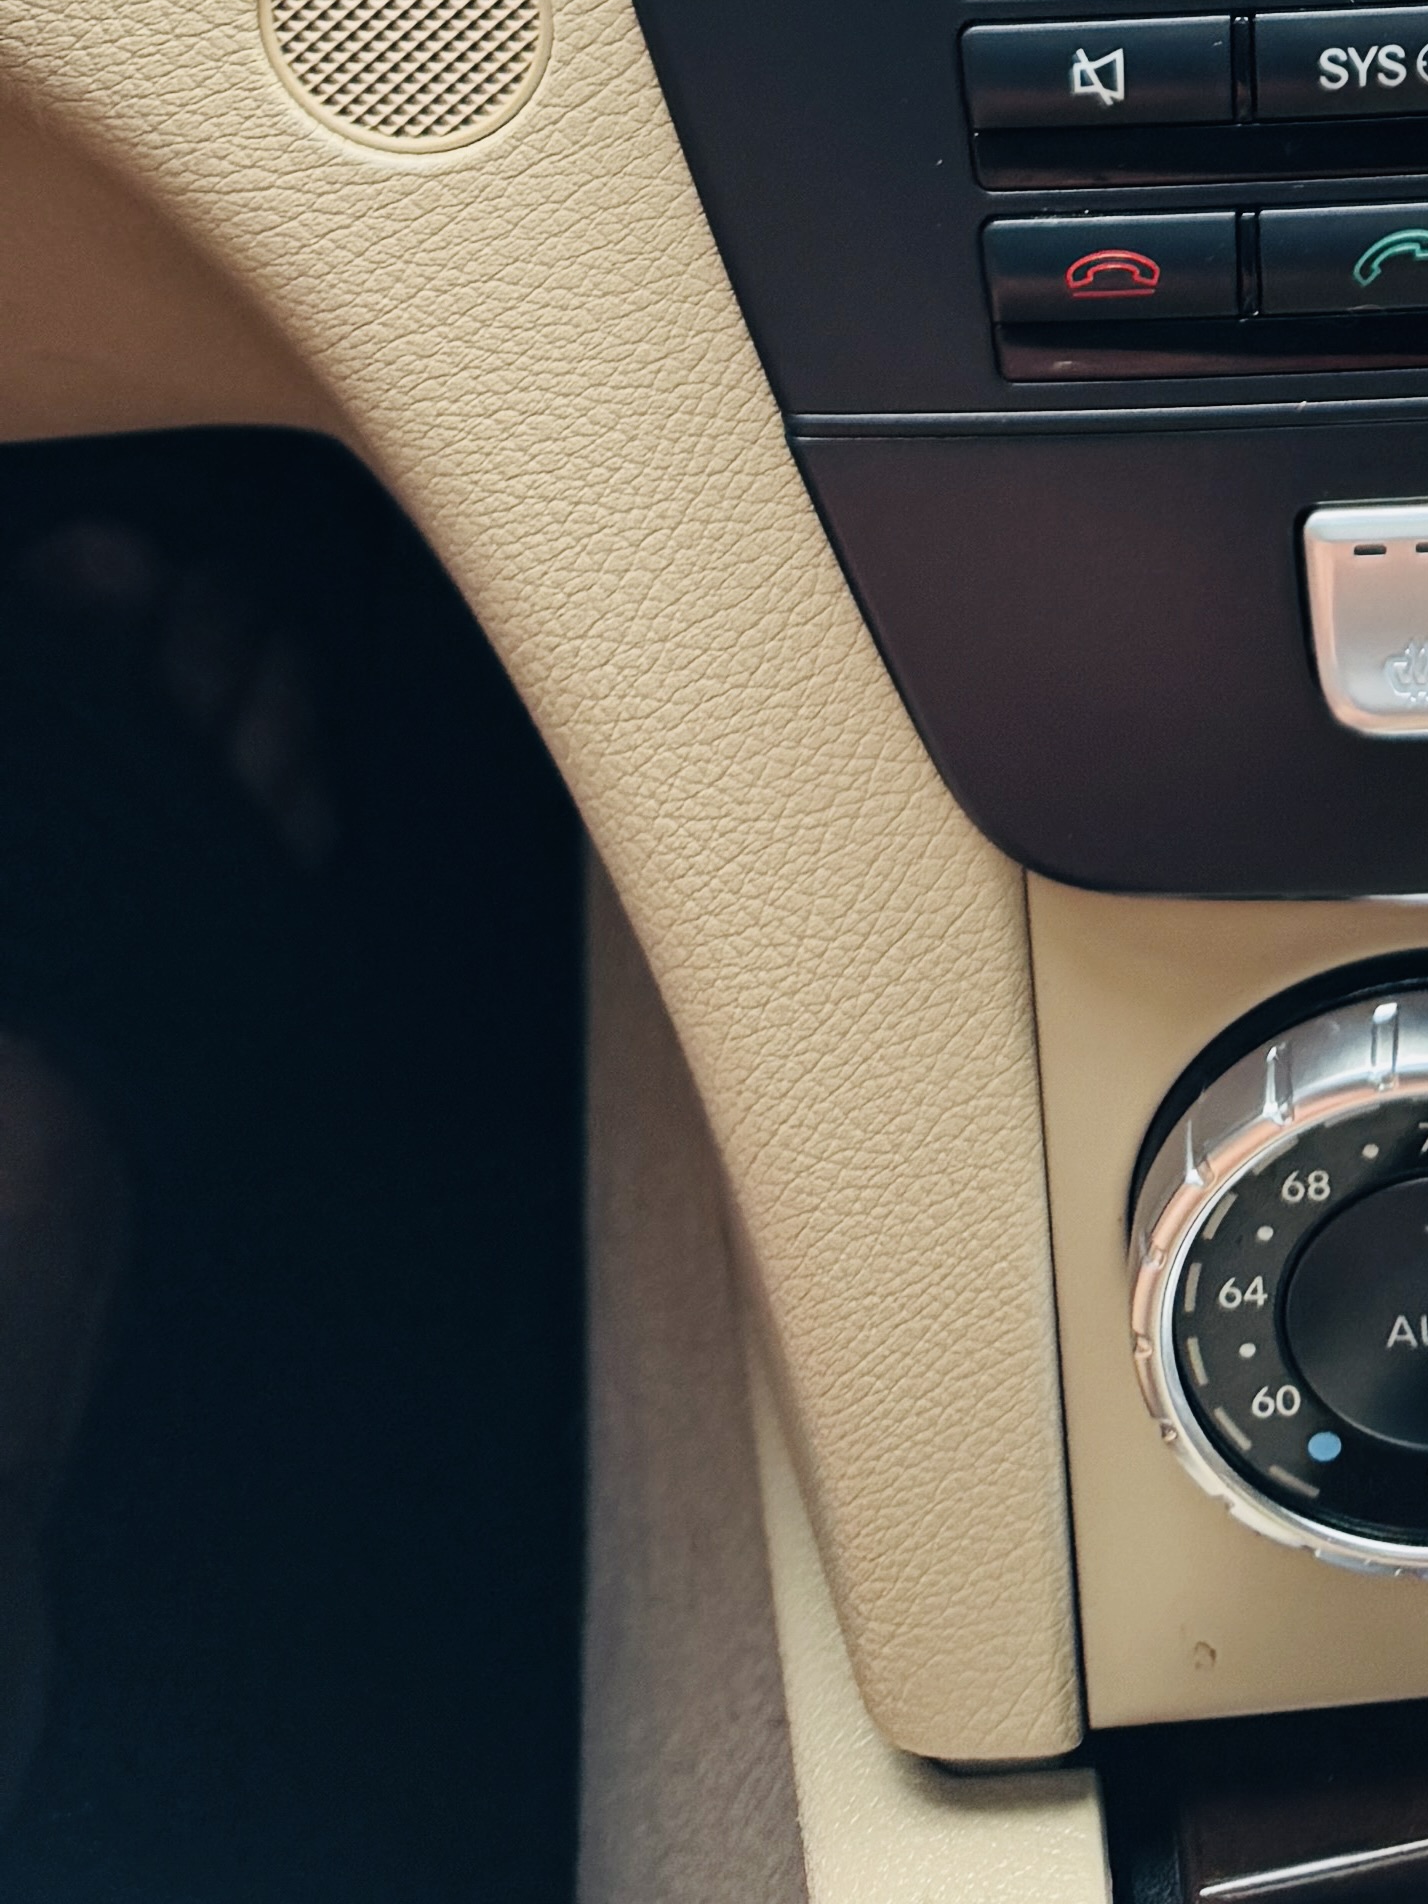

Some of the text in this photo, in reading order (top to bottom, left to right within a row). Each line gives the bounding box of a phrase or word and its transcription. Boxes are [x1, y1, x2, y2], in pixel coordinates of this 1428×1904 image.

[1320, 45, 1406, 89] SYS
[1282, 1171, 1330, 1203] 68
[1219, 1276, 1268, 1309] 64
[1252, 1385, 1300, 1418] 60
